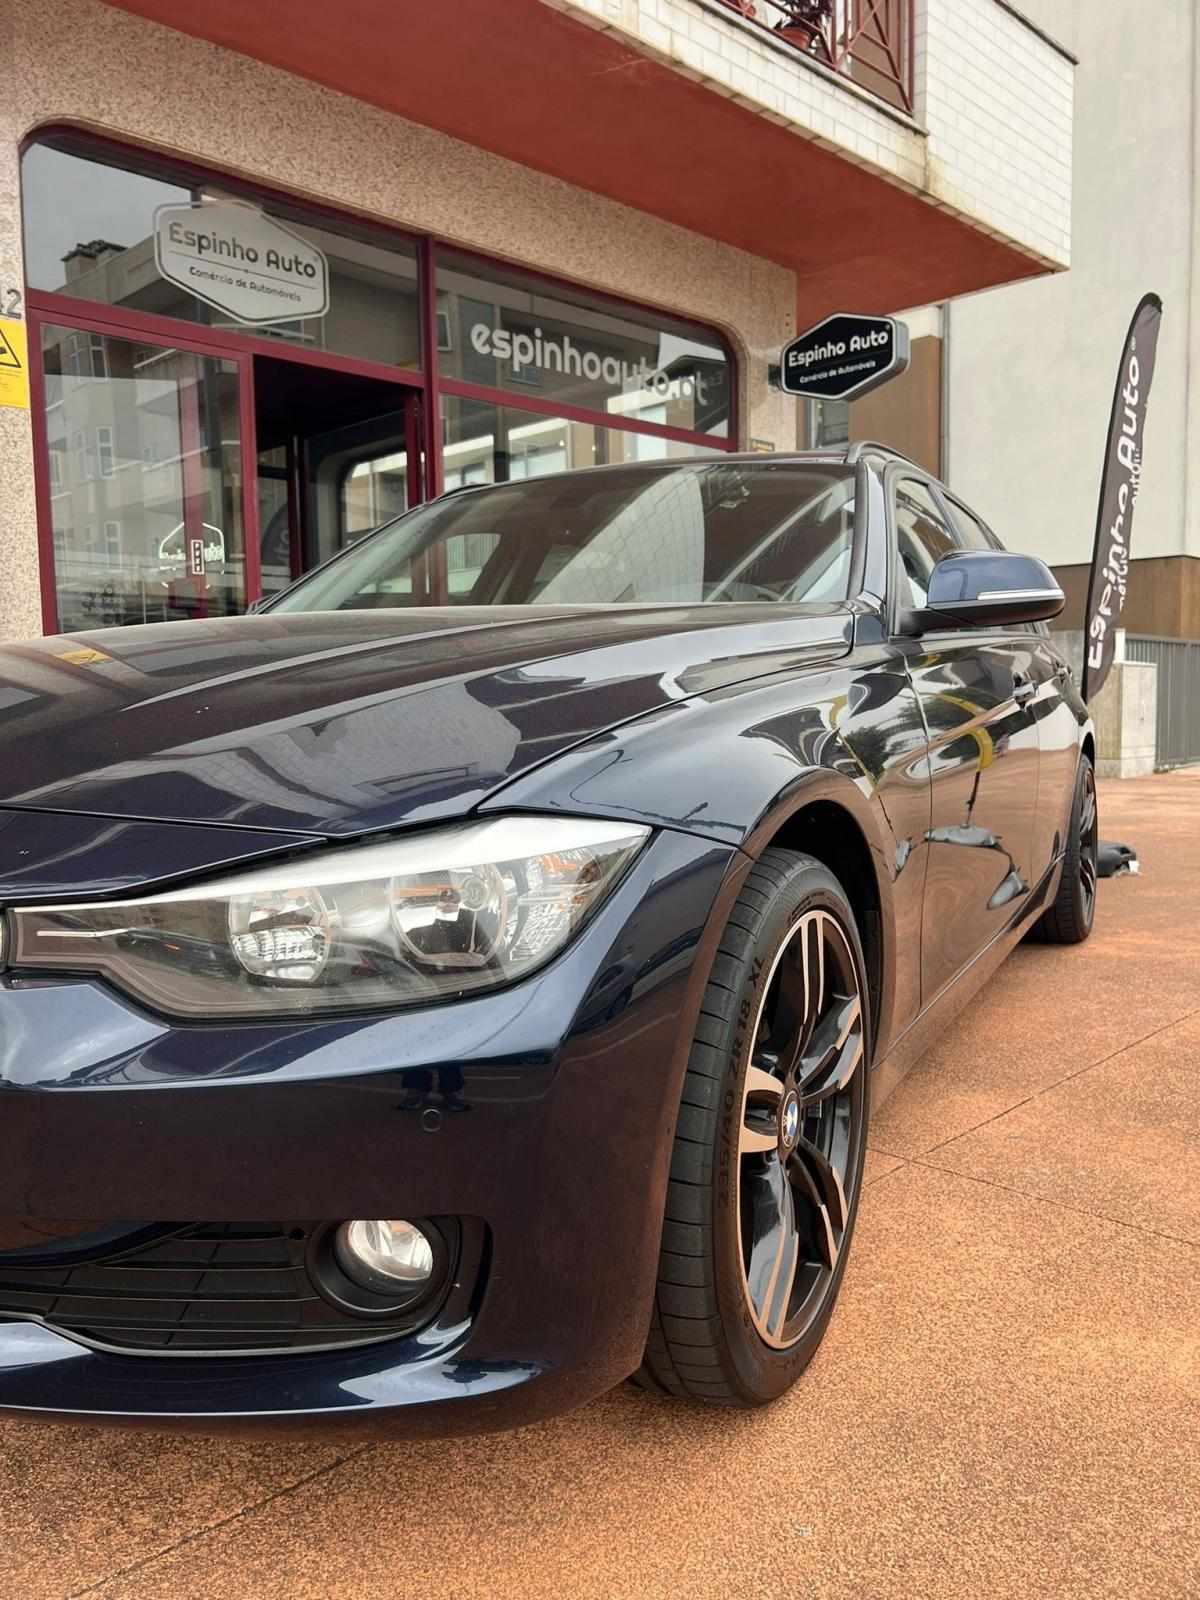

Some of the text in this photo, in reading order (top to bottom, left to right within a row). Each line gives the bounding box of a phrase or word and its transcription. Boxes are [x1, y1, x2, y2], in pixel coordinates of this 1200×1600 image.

[169, 221, 317, 278] Espinho Auto
[188, 266, 302, 302] Comércio de Automóveis
[788, 329, 889, 367] Espinho Auto
[828, 369, 838, 377] de
[1088, 355, 1140, 669] Espinho Auto
